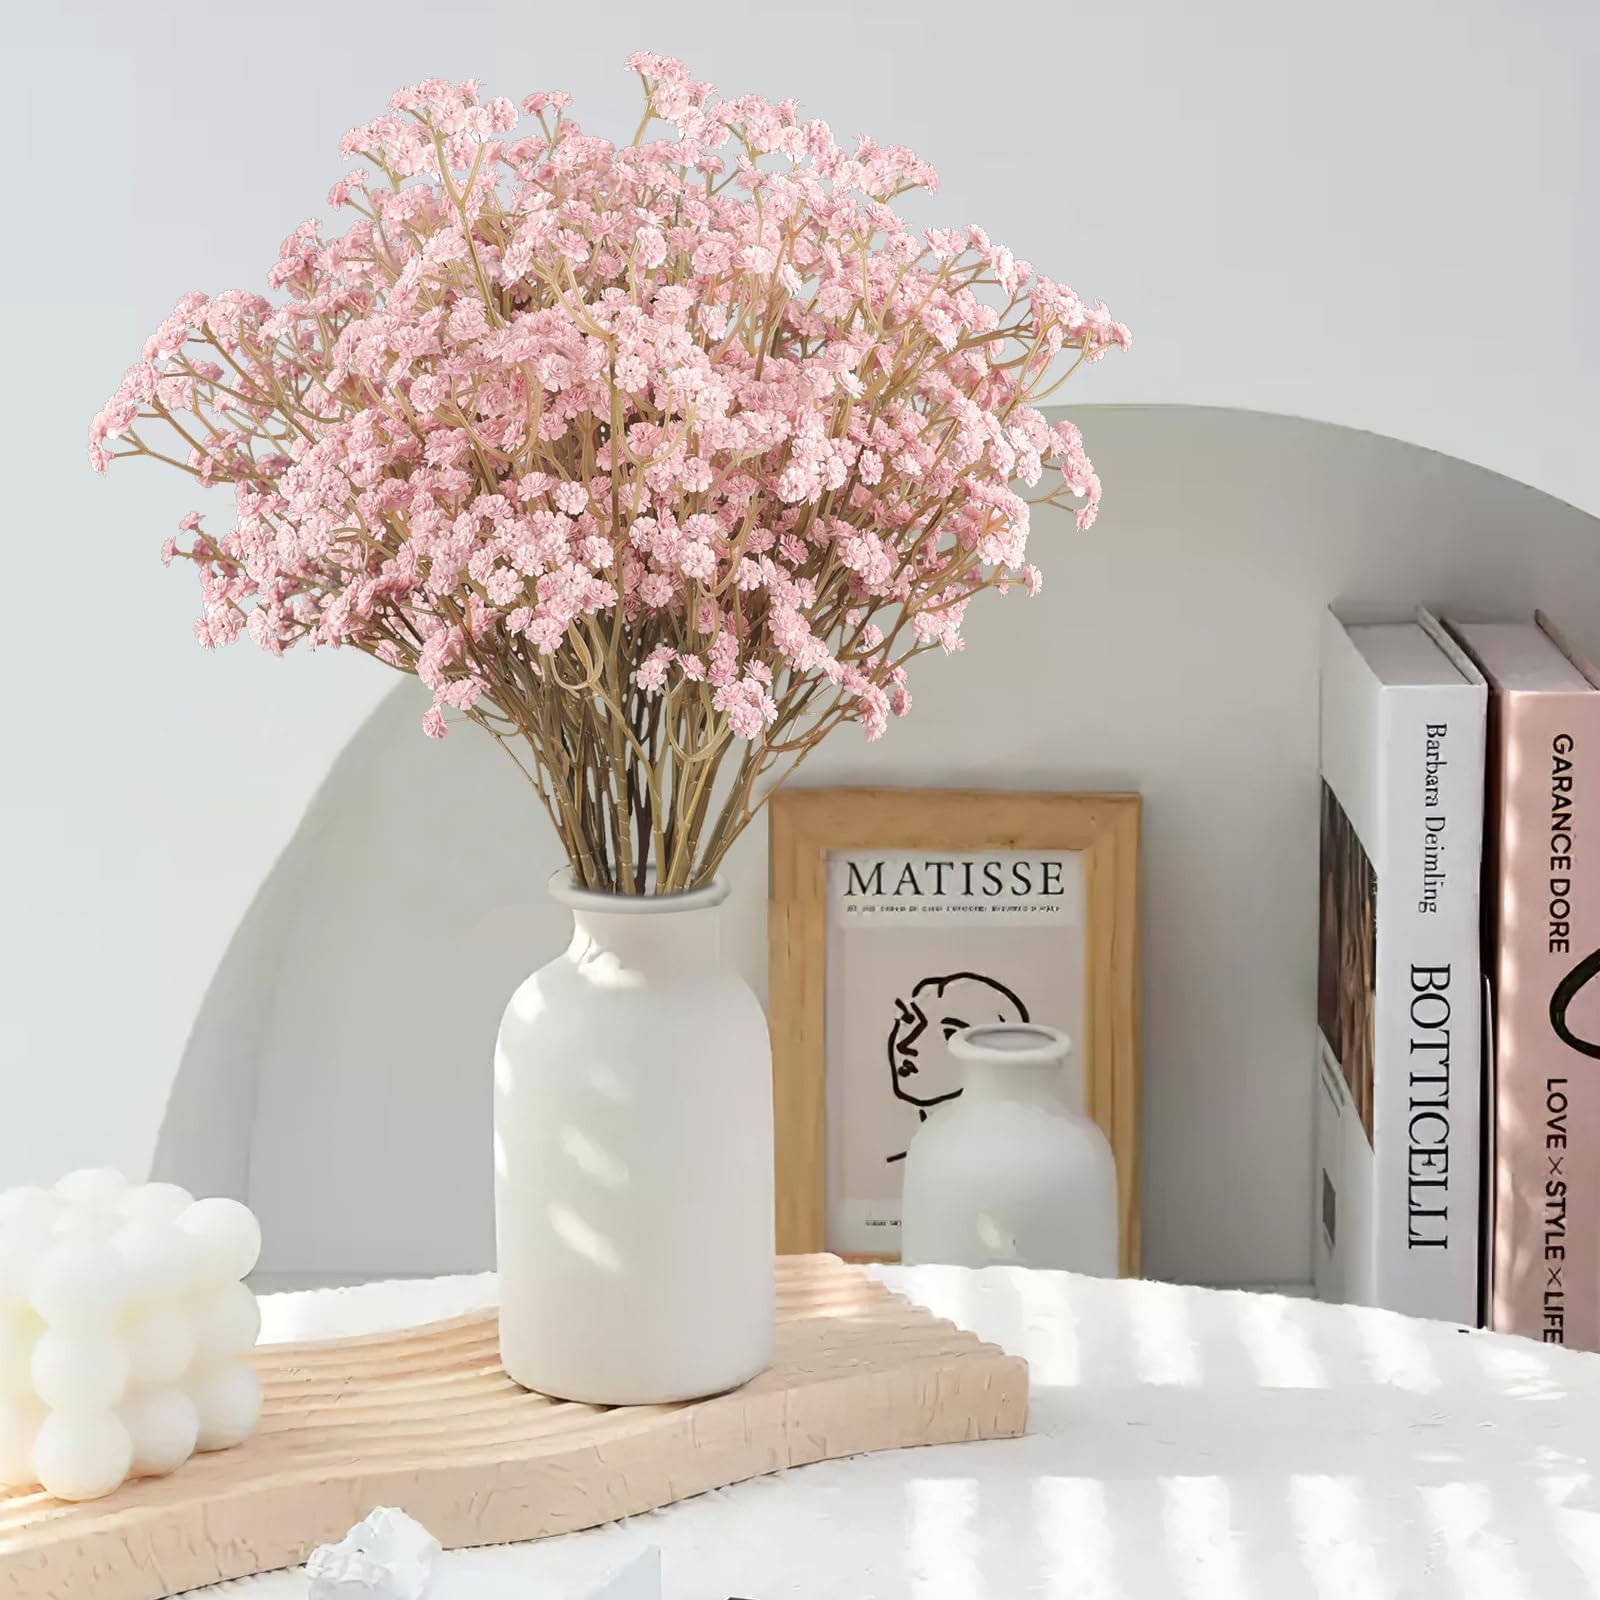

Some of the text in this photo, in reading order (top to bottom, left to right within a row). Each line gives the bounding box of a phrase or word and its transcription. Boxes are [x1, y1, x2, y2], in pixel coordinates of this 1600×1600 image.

[1418, 723, 1448, 913] Barbara Deimling
[1548, 733, 1574, 953] GARANCE DORE
[844, 861, 1065, 896] MATISSE
[1408, 963, 1451, 1250] BOTTICELLI
[1546, 1078, 1568, 1149] LOVE
[1544, 1180, 1566, 1260] STYLE
[1543, 1291, 1564, 1344] LIFE
